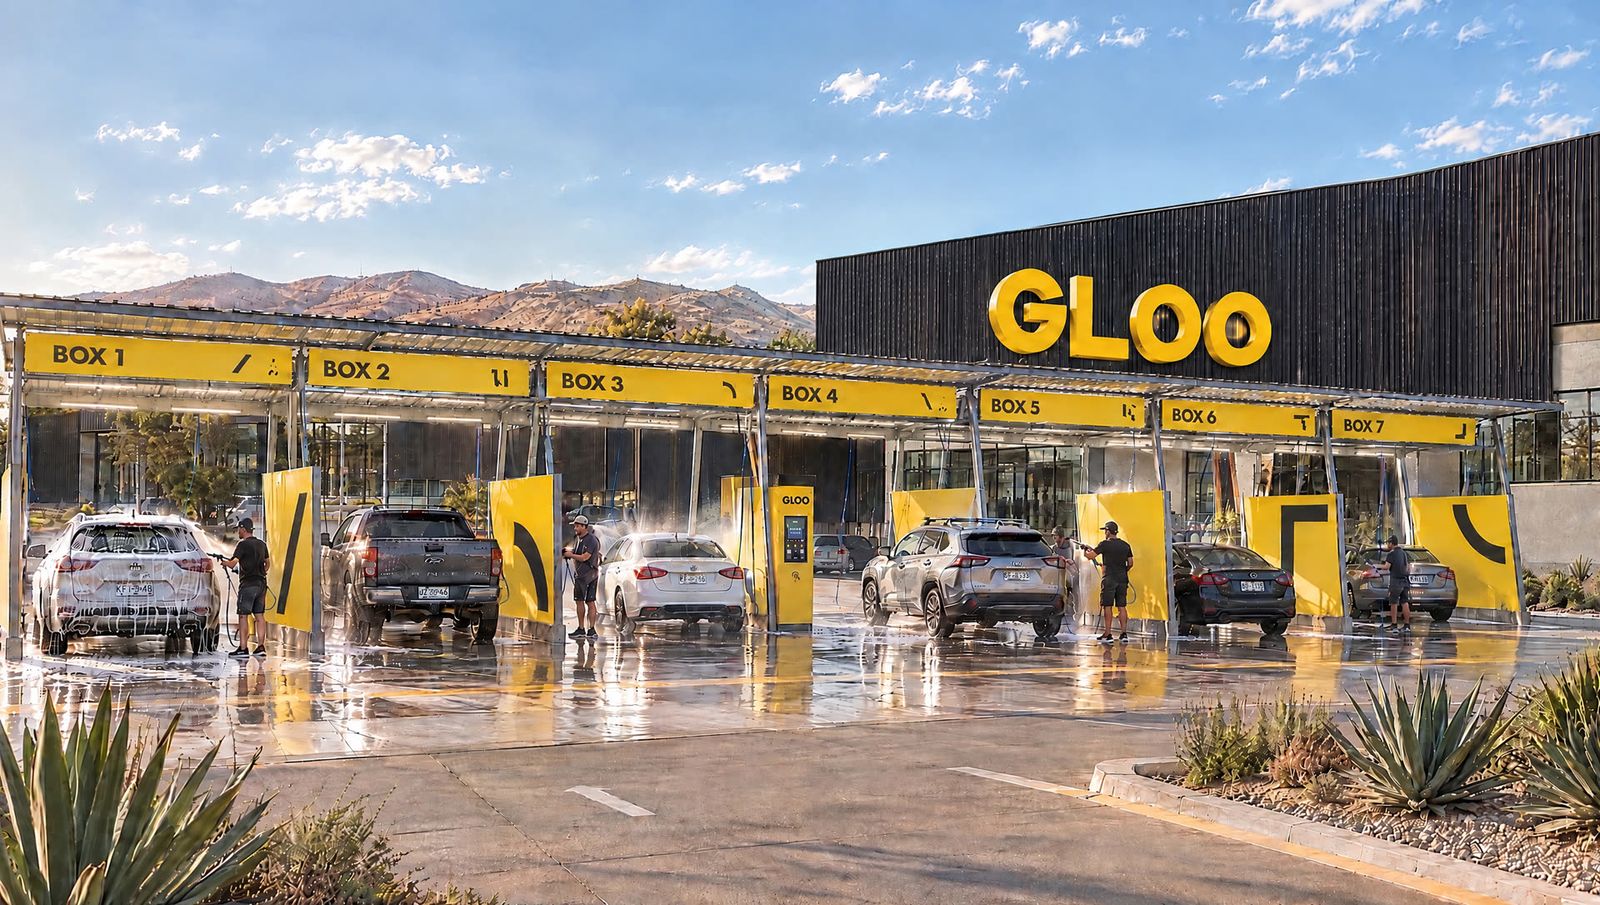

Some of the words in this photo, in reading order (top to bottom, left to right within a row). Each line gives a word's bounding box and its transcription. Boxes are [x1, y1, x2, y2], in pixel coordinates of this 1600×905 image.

[988, 268, 1272, 366] GLOO
[53, 344, 107, 365] BOX
[114, 348, 124, 367] 1
[323, 359, 372, 380] BOX
[377, 363, 390, 381] 2
[562, 372, 606, 391] BOX
[611, 375, 624, 393] 3
[782, 385, 822, 403] BOX
[826, 388, 839, 404] 4
[991, 398, 1027, 415] BOX
[1030, 400, 1040, 415] 5
[1172, 408, 1204, 424] BOX
[1206, 410, 1217, 425] 6
[1343, 418, 1373, 433] BOX
[1375, 419, 1385, 434] 7
[782, 495, 810, 505] GLOO
